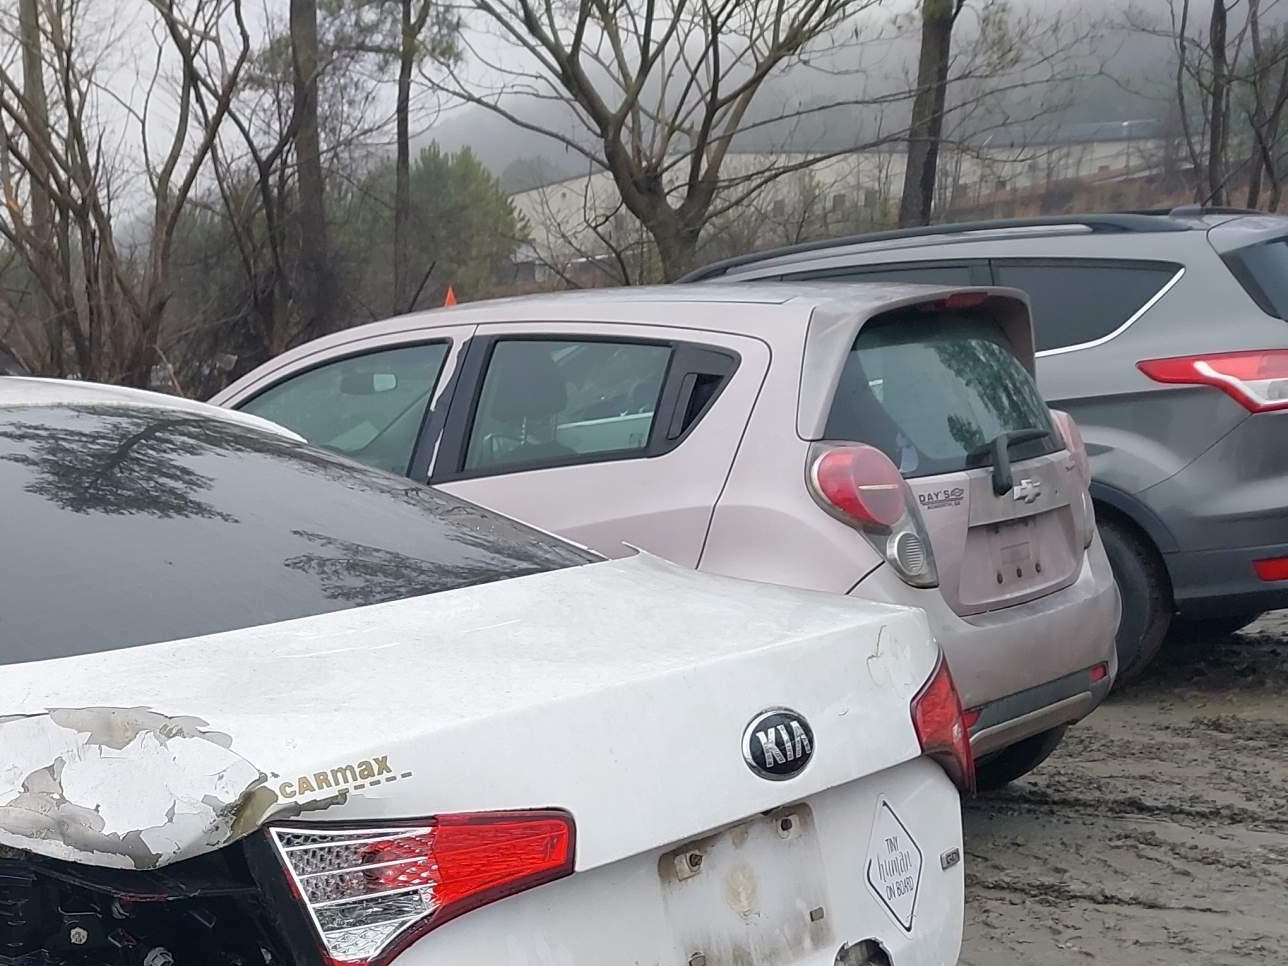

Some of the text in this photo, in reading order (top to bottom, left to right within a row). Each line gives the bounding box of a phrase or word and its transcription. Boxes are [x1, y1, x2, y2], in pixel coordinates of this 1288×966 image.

[755, 720, 812, 769] KIA
[884, 836, 900, 855] TINY
[877, 851, 912, 882] human
[885, 876, 915, 902] ON BOARD
